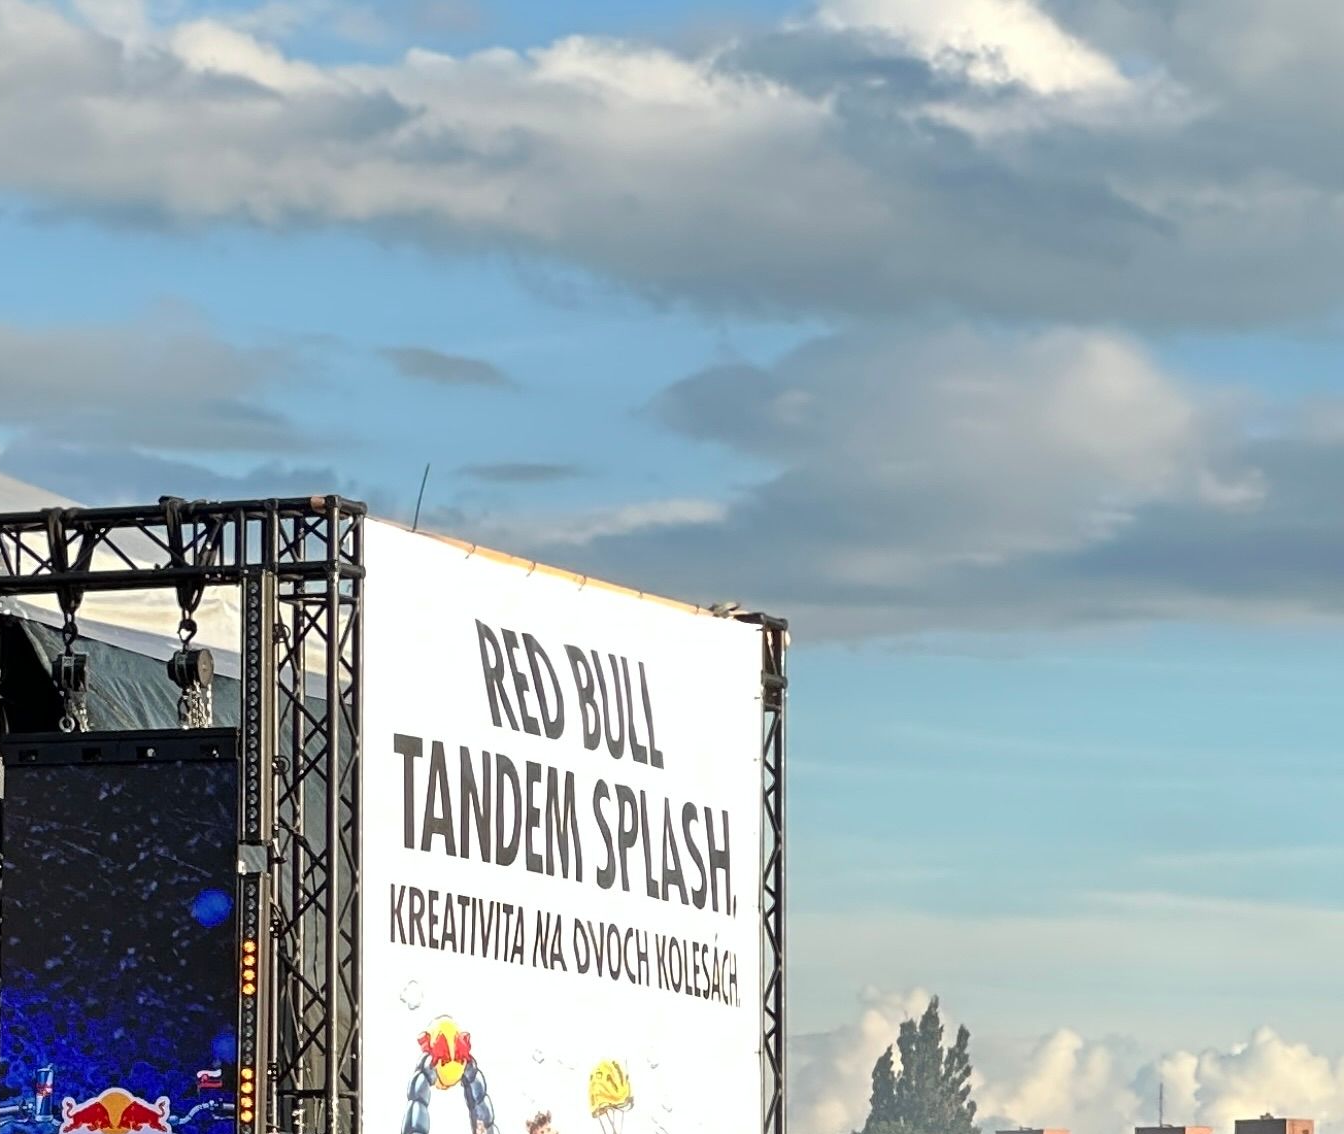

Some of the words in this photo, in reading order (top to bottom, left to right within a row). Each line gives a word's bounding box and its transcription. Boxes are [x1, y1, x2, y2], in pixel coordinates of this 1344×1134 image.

[474, 618, 565, 741] RED
[564, 643, 665, 770] BULL
[393, 733, 583, 883] TANDEM
[390, 883, 525, 966] KREATIVITA
[532, 909, 568, 973] NA
[573, 917, 650, 988] DVOCH
